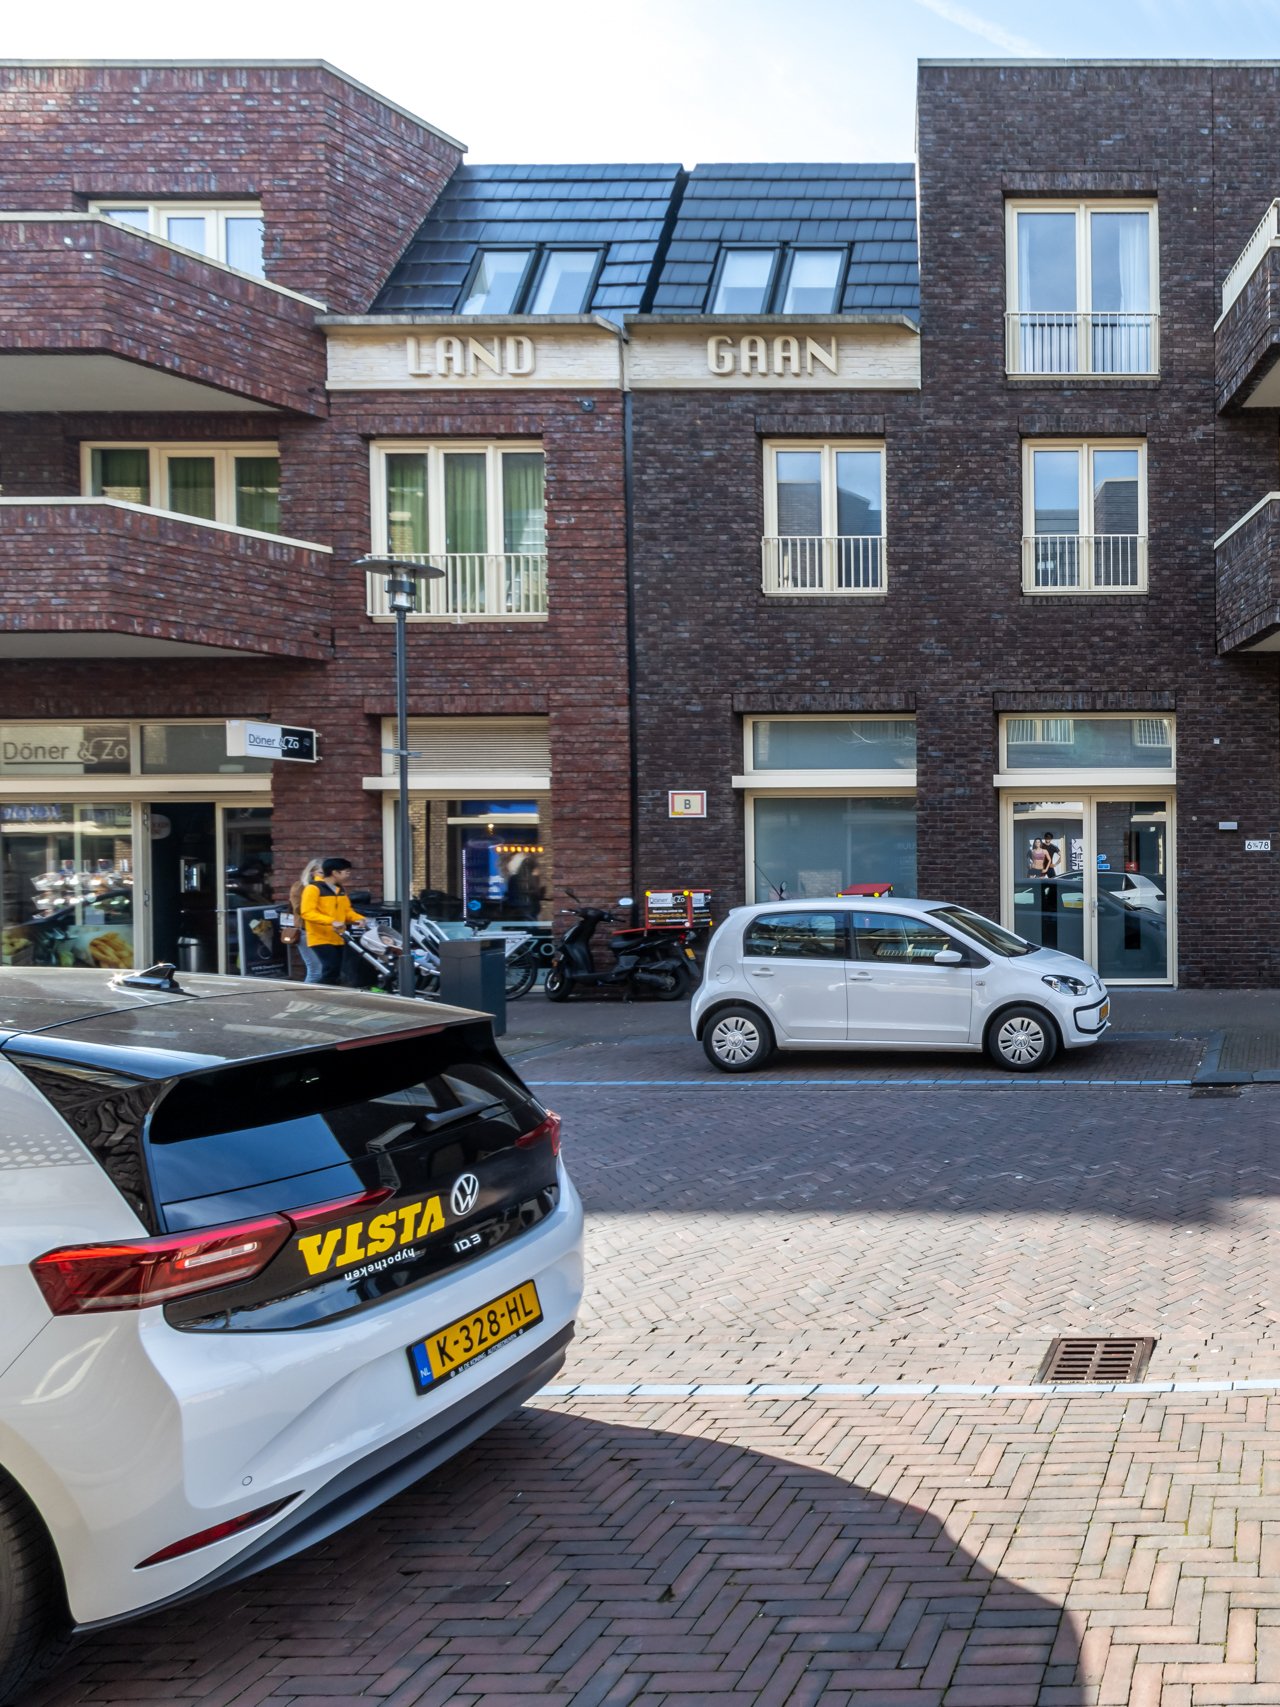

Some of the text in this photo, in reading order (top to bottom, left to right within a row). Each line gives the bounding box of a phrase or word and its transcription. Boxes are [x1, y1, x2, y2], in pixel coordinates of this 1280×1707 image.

[406, 335, 536, 377] LAND
[707, 335, 839, 377] GAAN
[3, 742, 70, 760] Döner
[101, 740, 128, 760] Zo
[248, 733, 276, 746] Döner
[288, 738, 299, 749] Zo
[684, 799, 691, 809] B
[298, 1195, 446, 1276] VISTA
[344, 1248, 415, 1281] hypotheken
[436, 1293, 533, 1367] K-328-HL
[420, 1367, 431, 1378] NL
